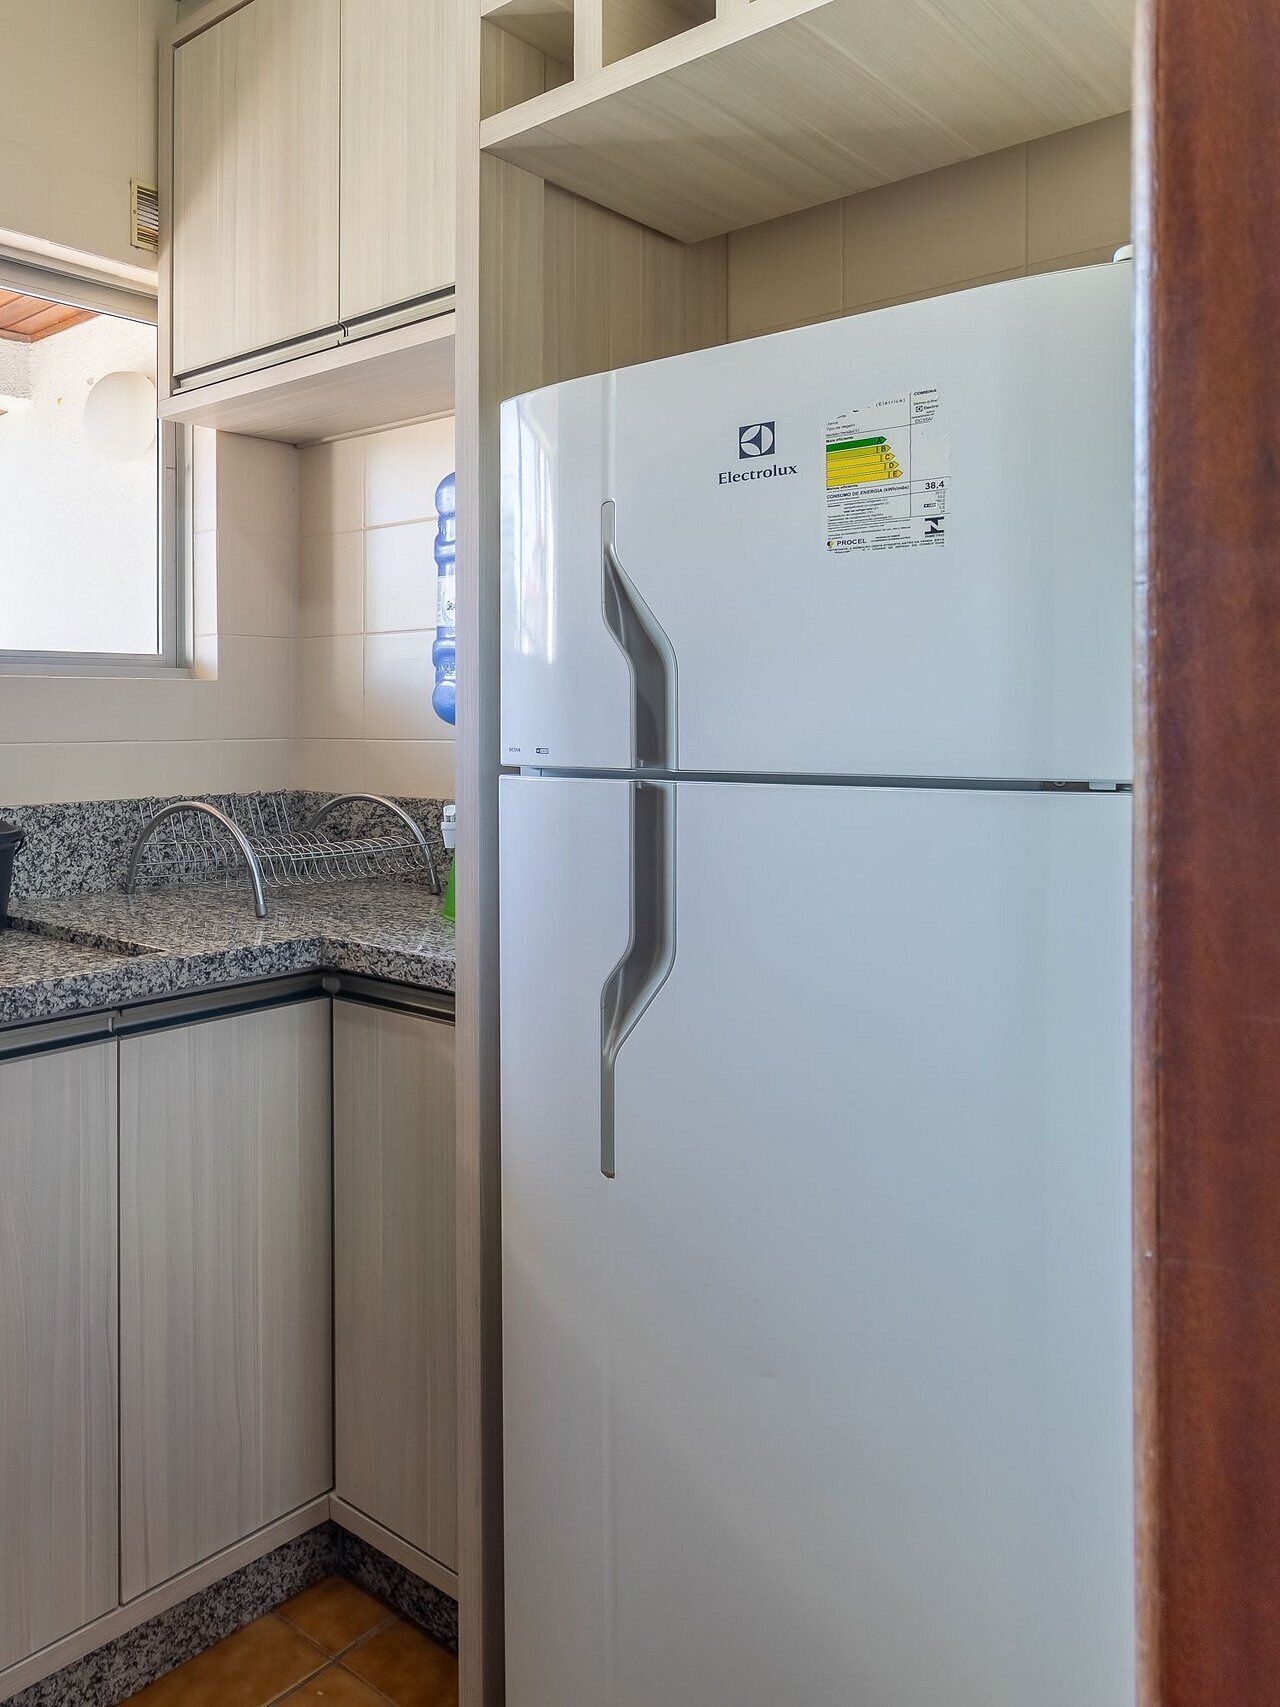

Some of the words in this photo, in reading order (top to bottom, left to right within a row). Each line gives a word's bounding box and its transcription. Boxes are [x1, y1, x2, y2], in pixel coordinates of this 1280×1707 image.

[718, 464, 798, 485] Electrolux
[925, 480, 945, 490] 38.4
[836, 538, 867, 546] PROCEL
